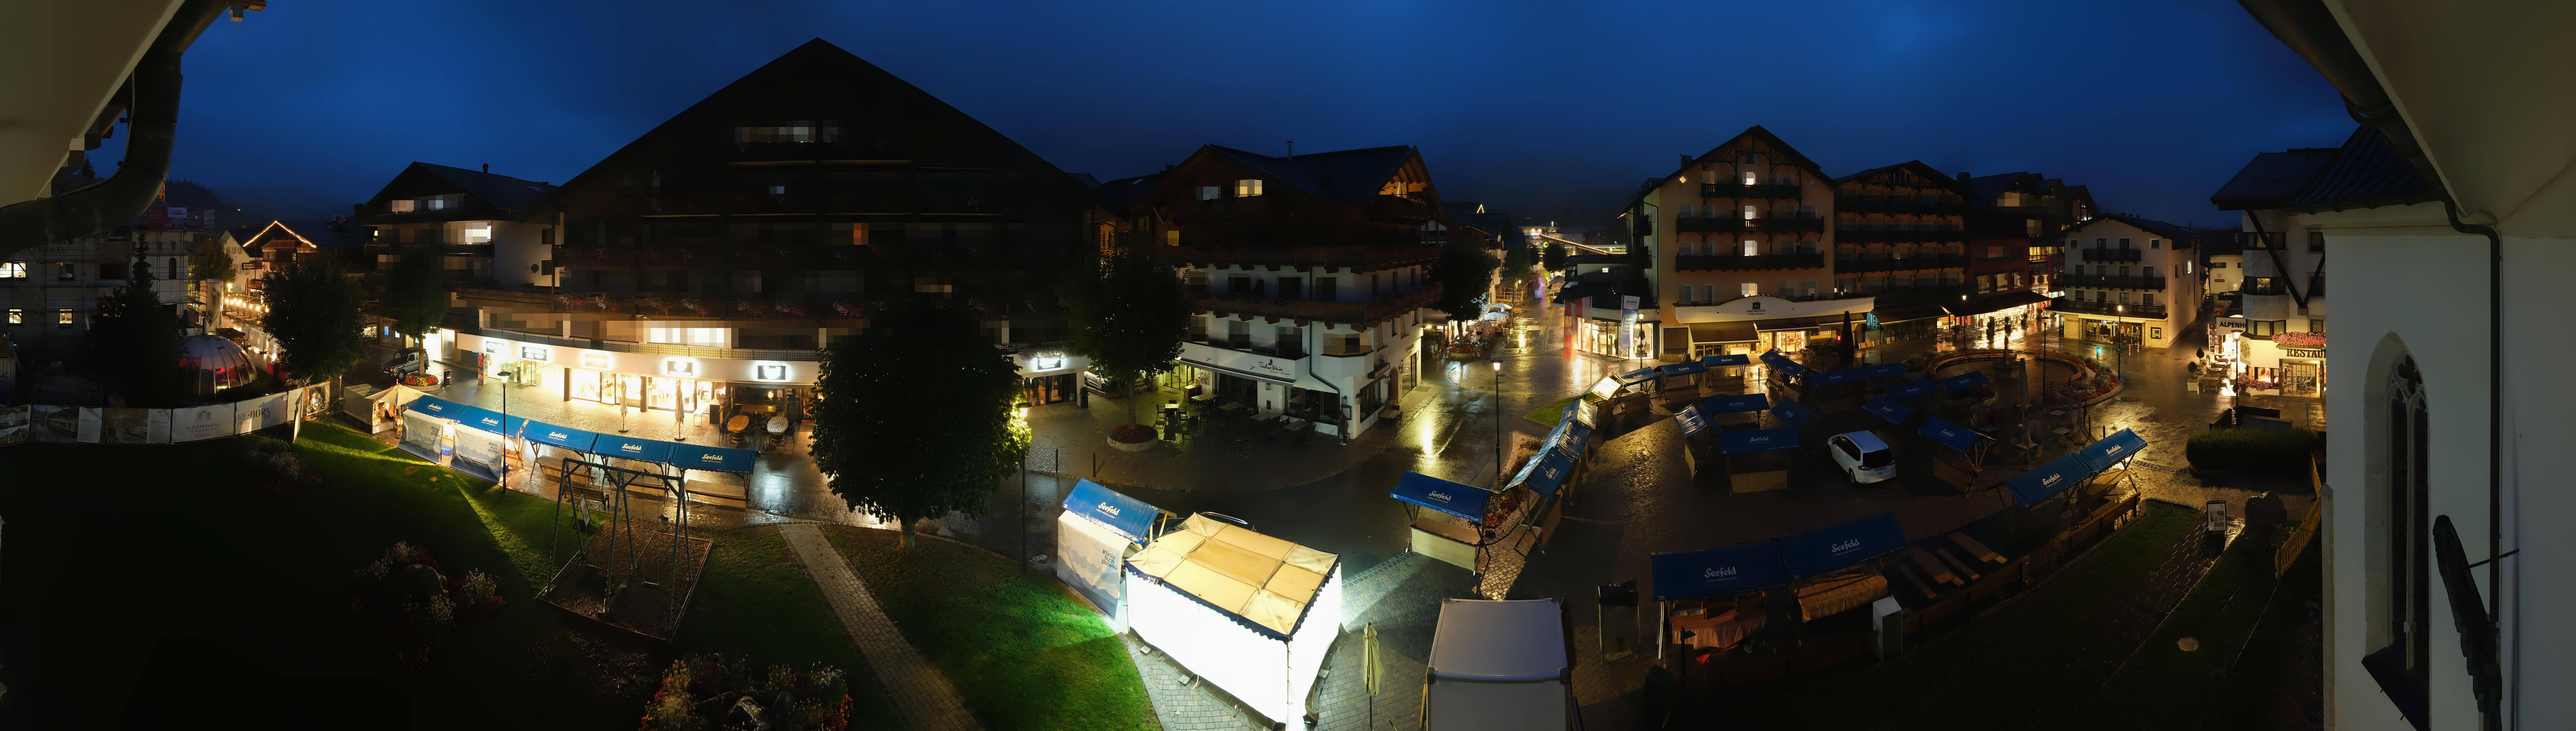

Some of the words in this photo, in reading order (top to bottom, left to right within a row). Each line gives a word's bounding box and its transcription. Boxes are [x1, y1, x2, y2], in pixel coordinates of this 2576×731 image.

[1375, 364, 1389, 378] RESTAURANT
[2106, 444, 2121, 454] Seefeld
[2043, 473, 2060, 485] Seefeld
[1429, 490, 1452, 501] Seefeld
[1098, 502, 1120, 515] Seefeld
[1831, 538, 1860, 552] Seefeld
[1102, 549, 1115, 559] #tirols
[1105, 555, 1114, 564] hoch
[1102, 559, 1117, 570] plateau
[1704, 566, 1736, 578] Seefeld
